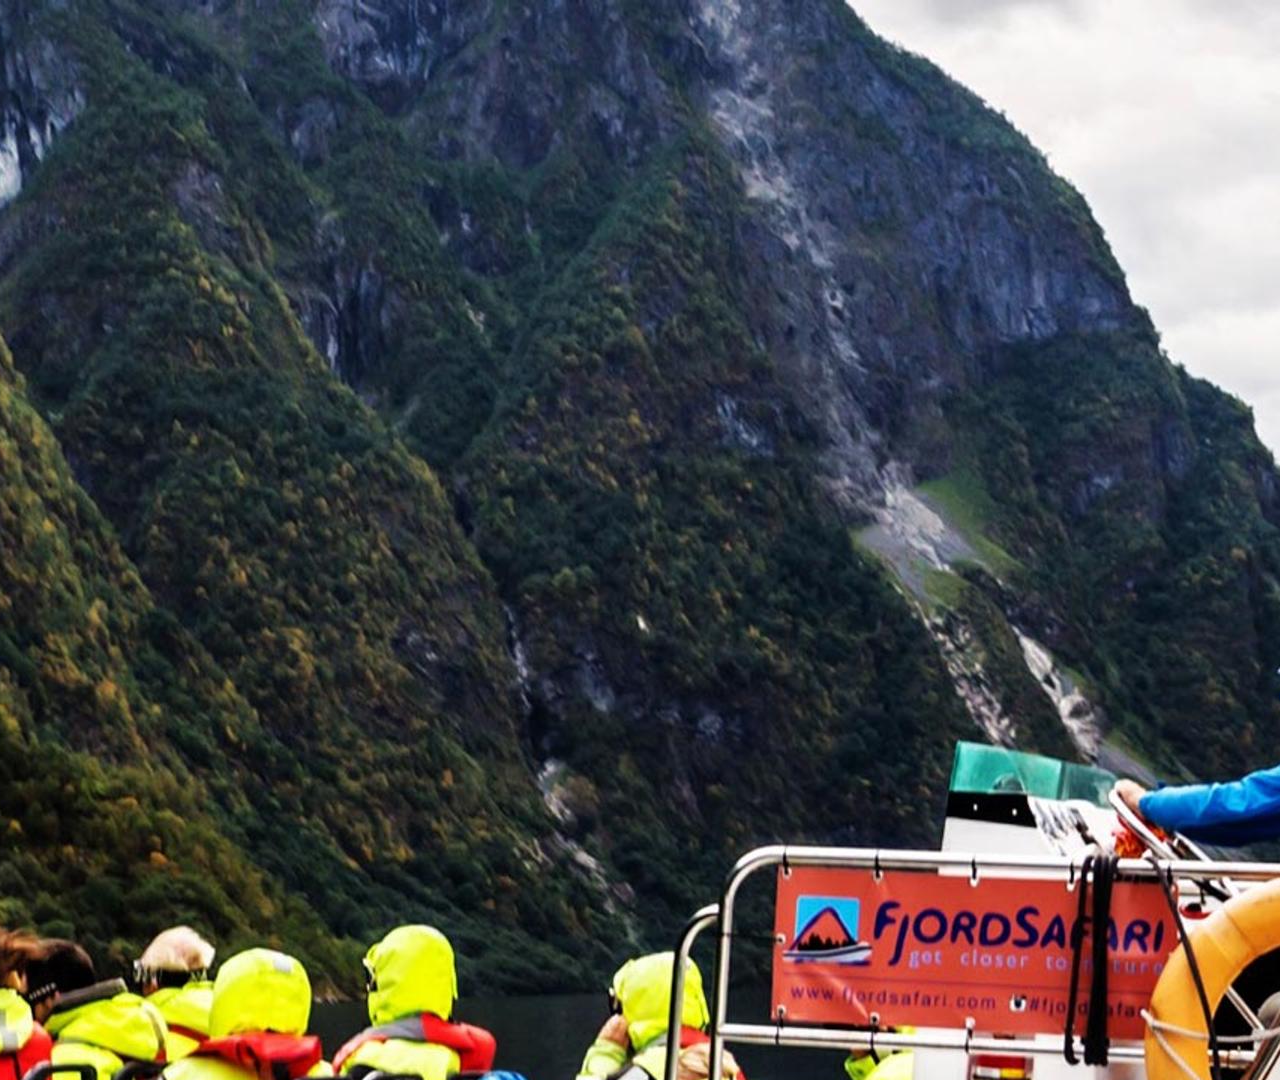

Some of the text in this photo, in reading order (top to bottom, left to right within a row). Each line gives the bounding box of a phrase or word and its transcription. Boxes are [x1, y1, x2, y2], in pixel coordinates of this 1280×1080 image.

[908, 951, 943, 969] get
[960, 949, 1028, 969] closer
[1046, 956, 1068, 971] to
